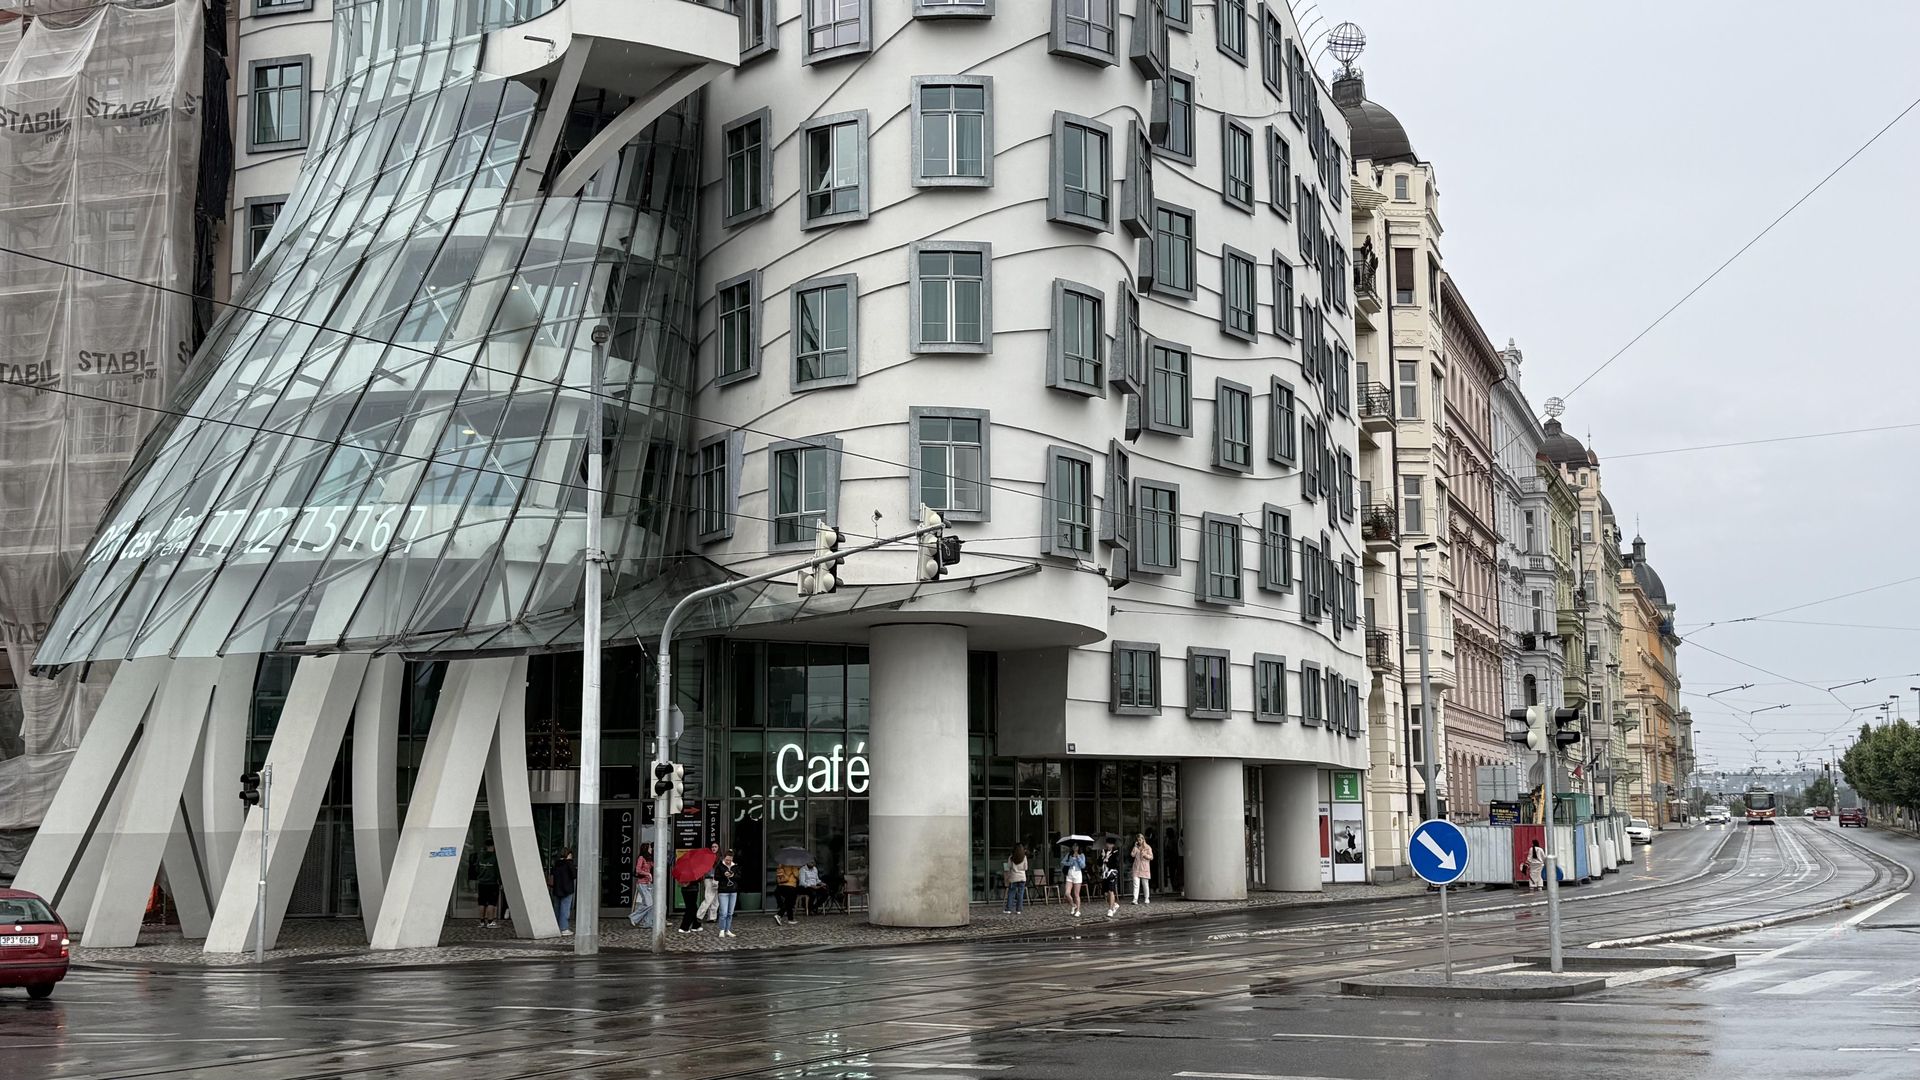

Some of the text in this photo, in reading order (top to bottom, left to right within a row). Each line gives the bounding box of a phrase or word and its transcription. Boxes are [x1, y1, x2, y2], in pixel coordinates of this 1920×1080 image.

[86, 96, 166, 121] STABIL
[776, 741, 870, 793] Café
[620, 811, 632, 905] GLASS BAR
[19, 936, 36, 944] 6623
